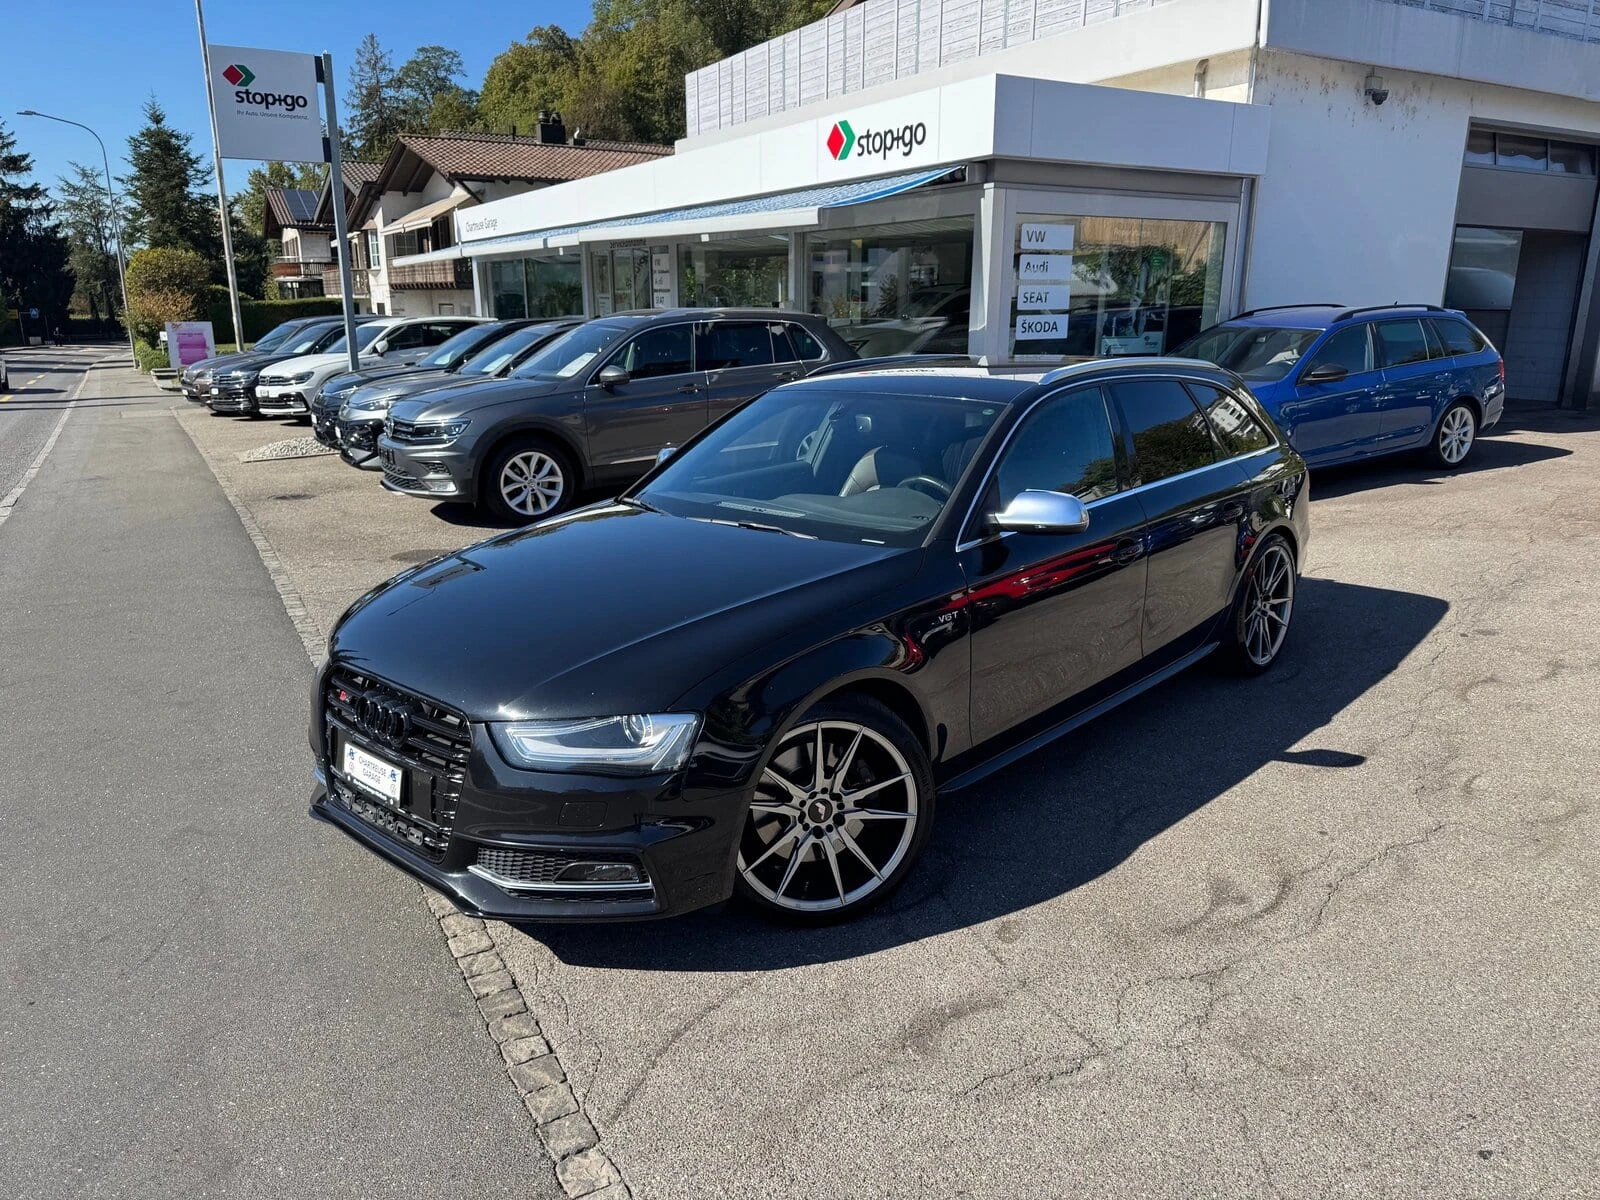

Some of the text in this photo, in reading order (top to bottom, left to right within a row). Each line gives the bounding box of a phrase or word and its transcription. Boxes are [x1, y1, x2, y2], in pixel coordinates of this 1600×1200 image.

[235, 88, 308, 112] stop+go
[857, 121, 927, 161] stop+go
[1026, 230, 1046, 243] VW
[1024, 261, 1049, 273] Audi
[1023, 291, 1049, 304] SEAT
[1021, 319, 1058, 334] ŠKODA
